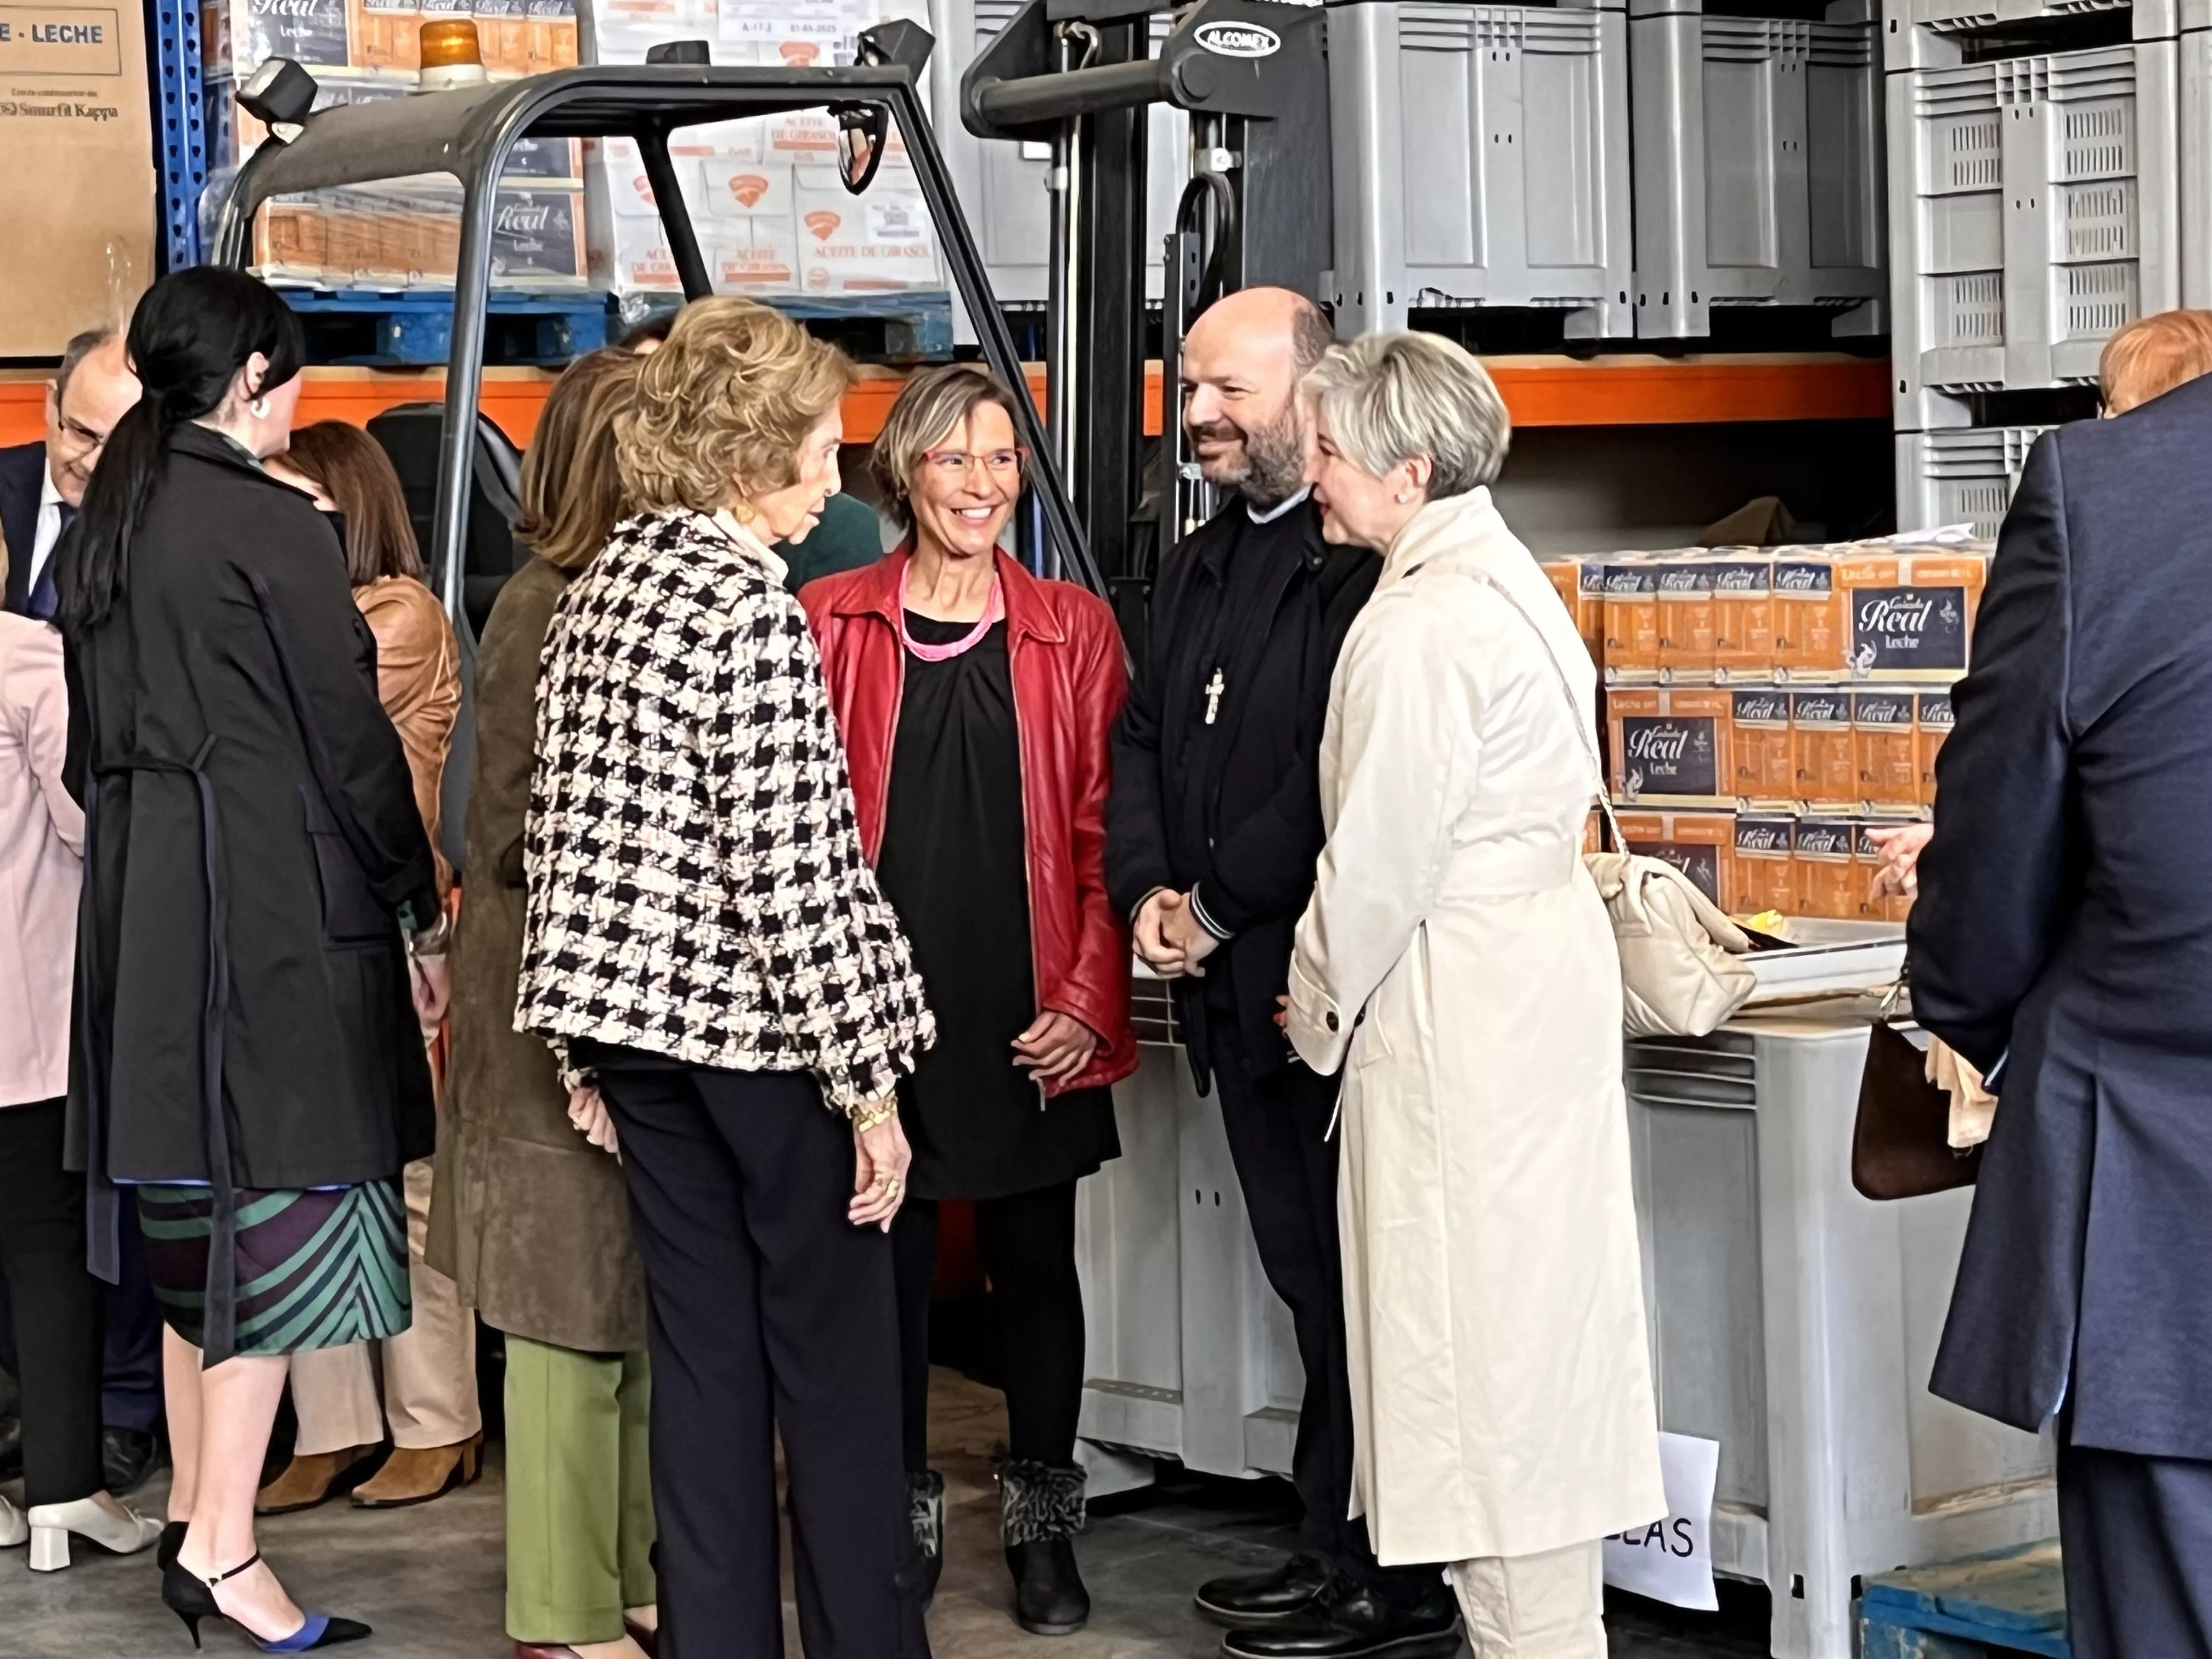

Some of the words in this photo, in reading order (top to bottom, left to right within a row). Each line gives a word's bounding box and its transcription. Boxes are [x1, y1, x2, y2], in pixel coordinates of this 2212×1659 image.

[32, 24, 103, 43] LECHE
[1858, 599, 1933, 632] Real
[1885, 634, 1920, 648] Leche
[1627, 729, 1689, 759] Real
